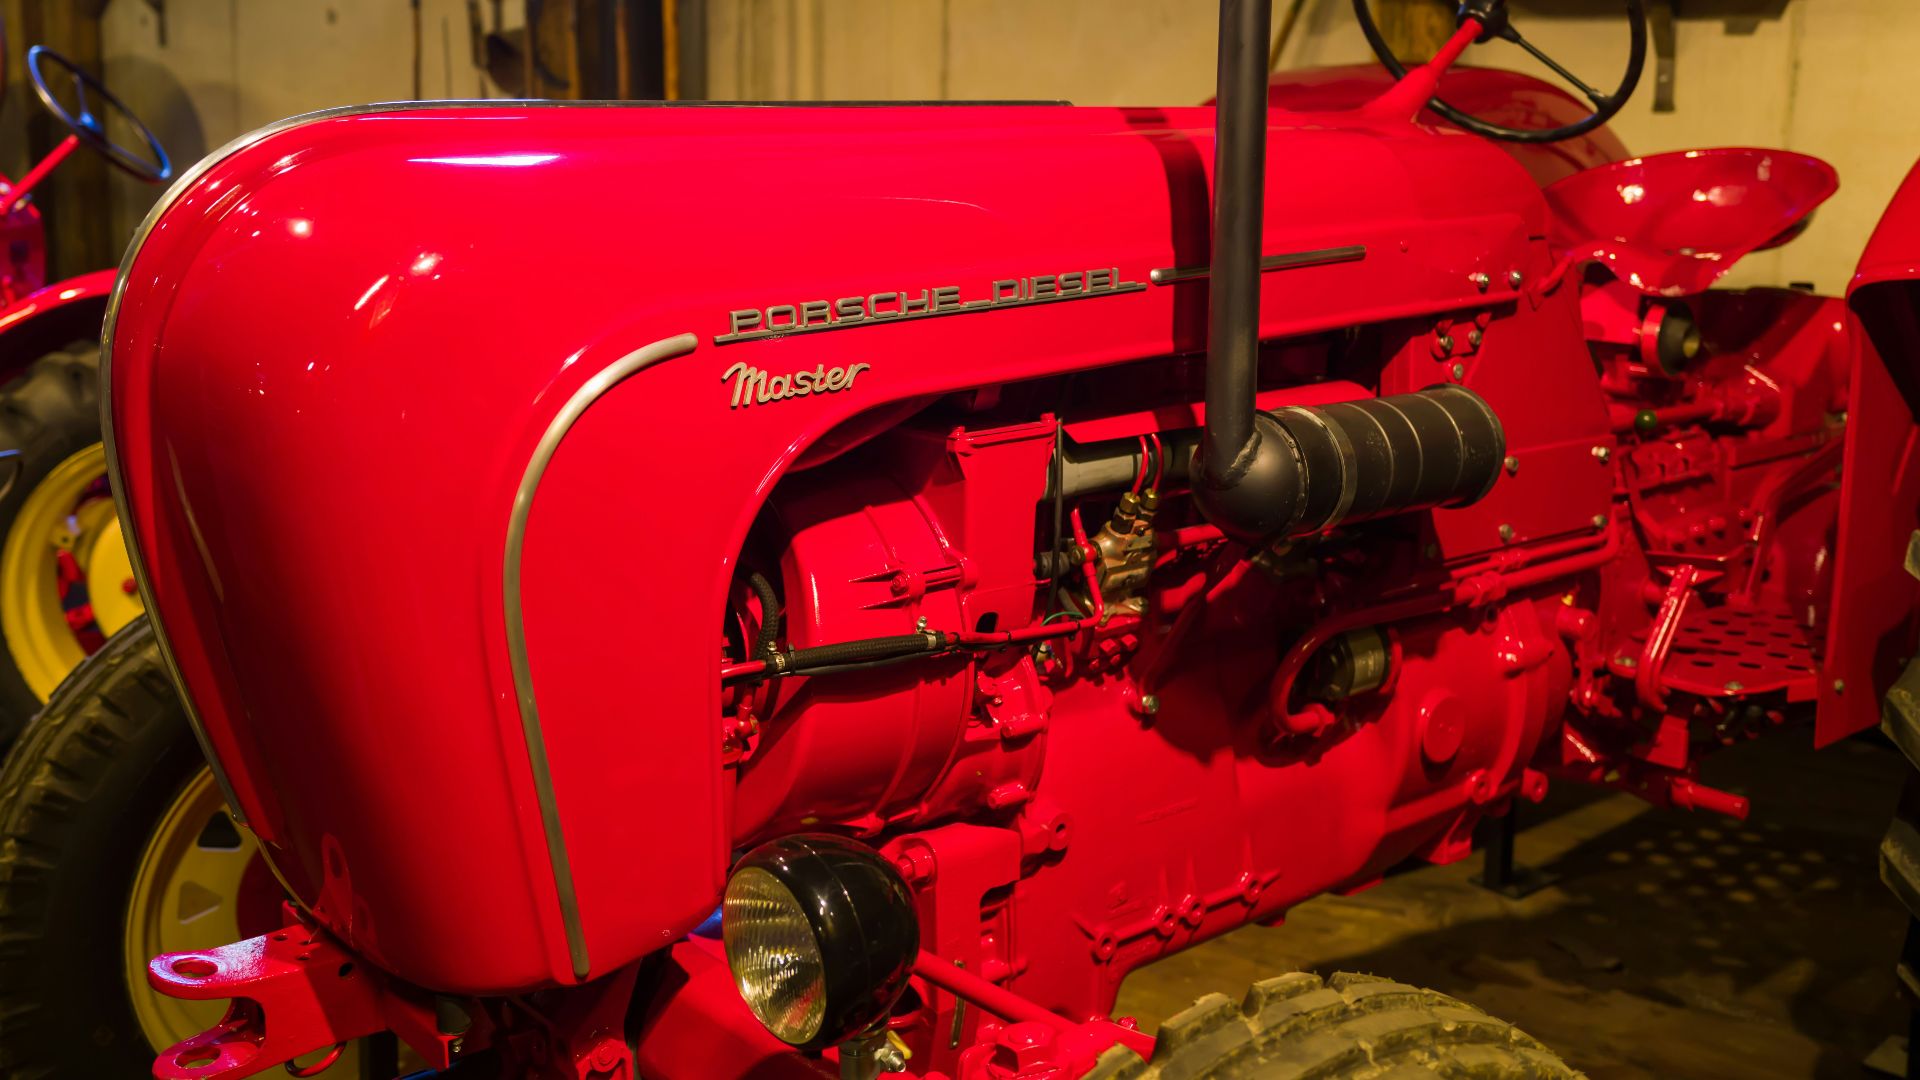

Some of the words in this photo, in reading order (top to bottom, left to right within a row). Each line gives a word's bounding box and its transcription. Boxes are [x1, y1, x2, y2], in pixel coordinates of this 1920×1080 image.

[730, 285, 961, 336] PORSCHE
[993, 267, 1138, 304] DIESEL
[721, 361, 871, 407] Master
